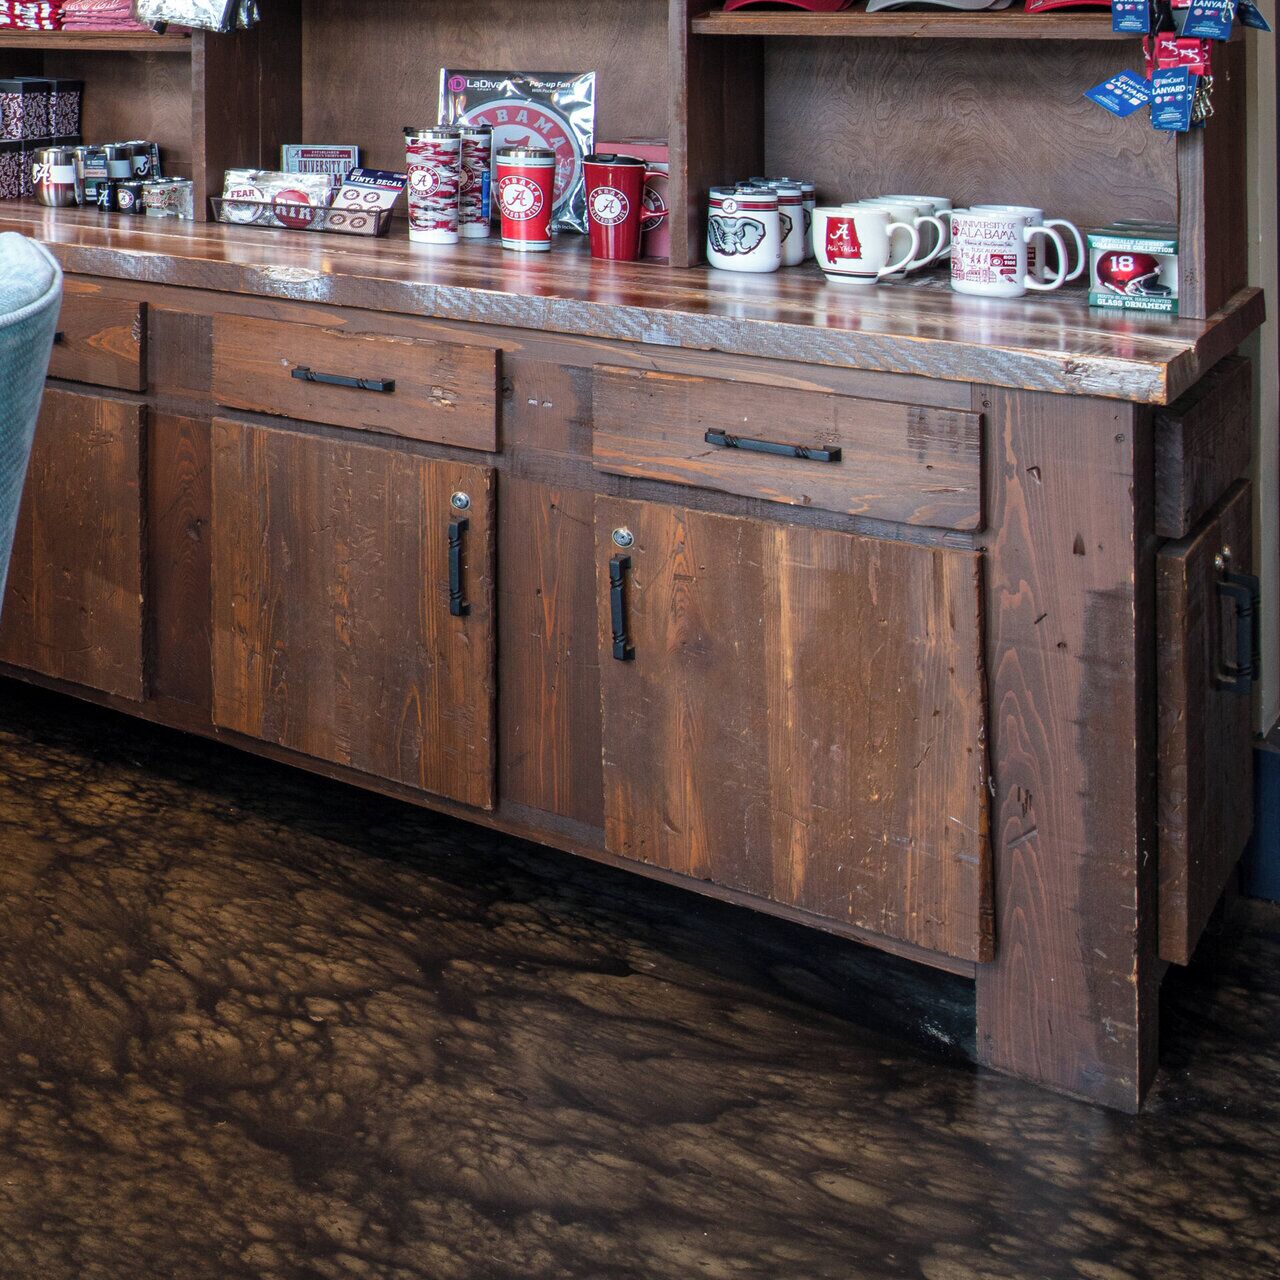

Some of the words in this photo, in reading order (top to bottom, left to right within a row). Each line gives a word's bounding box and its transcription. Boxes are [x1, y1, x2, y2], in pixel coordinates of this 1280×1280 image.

[1193, 0, 1235, 9] LANYARD
[529, 81, 557, 89] Pop-up
[556, 81, 573, 89] Fan
[1110, 78, 1149, 102] LANYARD
[1152, 84, 1187, 96] LANYARD
[298, 159, 341, 173] UNIVERSITY
[343, 160, 352, 173] OF
[408, 165, 438, 182] ALABAMA
[350, 174, 376, 186] VINYL
[376, 177, 403, 189] DECAL
[230, 189, 255, 198] FEAR
[499, 176, 541, 202] ALABAMA
[590, 187, 628, 207] ALABAMA
[499, 199, 526, 220] CRIMSON
[525, 200, 542, 220] TIDE
[590, 206, 613, 225] CRIMSON
[959, 220, 1007, 230] UNIVERSITY
[1007, 222, 1017, 230] OF
[959, 227, 1017, 241] ALABAMA
[1132, 244, 1175, 254] COLLECTION
[1109, 255, 1135, 273] 18
[1097, 298, 1123, 307] GLASS
[1124, 300, 1173, 311] ORNAMENT
